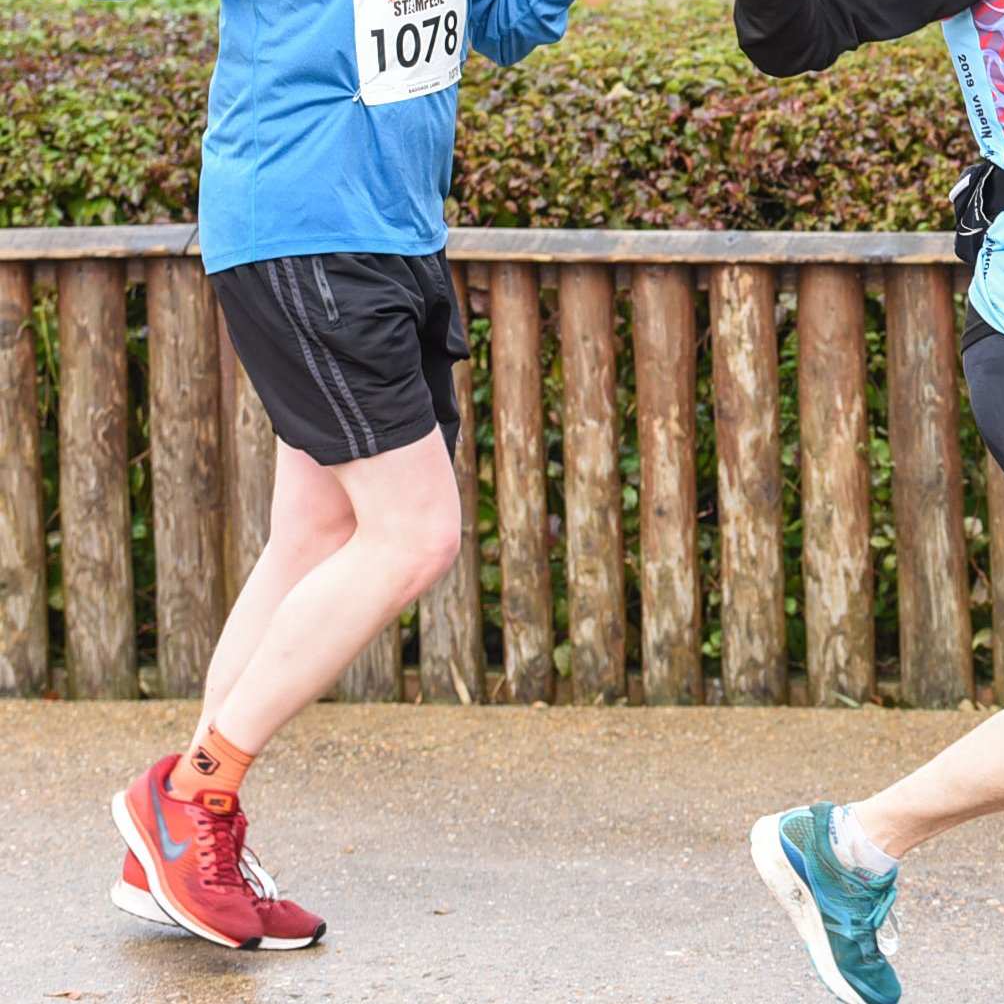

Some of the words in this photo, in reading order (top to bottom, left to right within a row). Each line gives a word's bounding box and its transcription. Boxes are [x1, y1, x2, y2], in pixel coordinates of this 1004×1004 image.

[371, 10, 458, 73] 1078
[958, 54, 975, 88] 2019
[972, 94, 993, 139] VIRGIN
